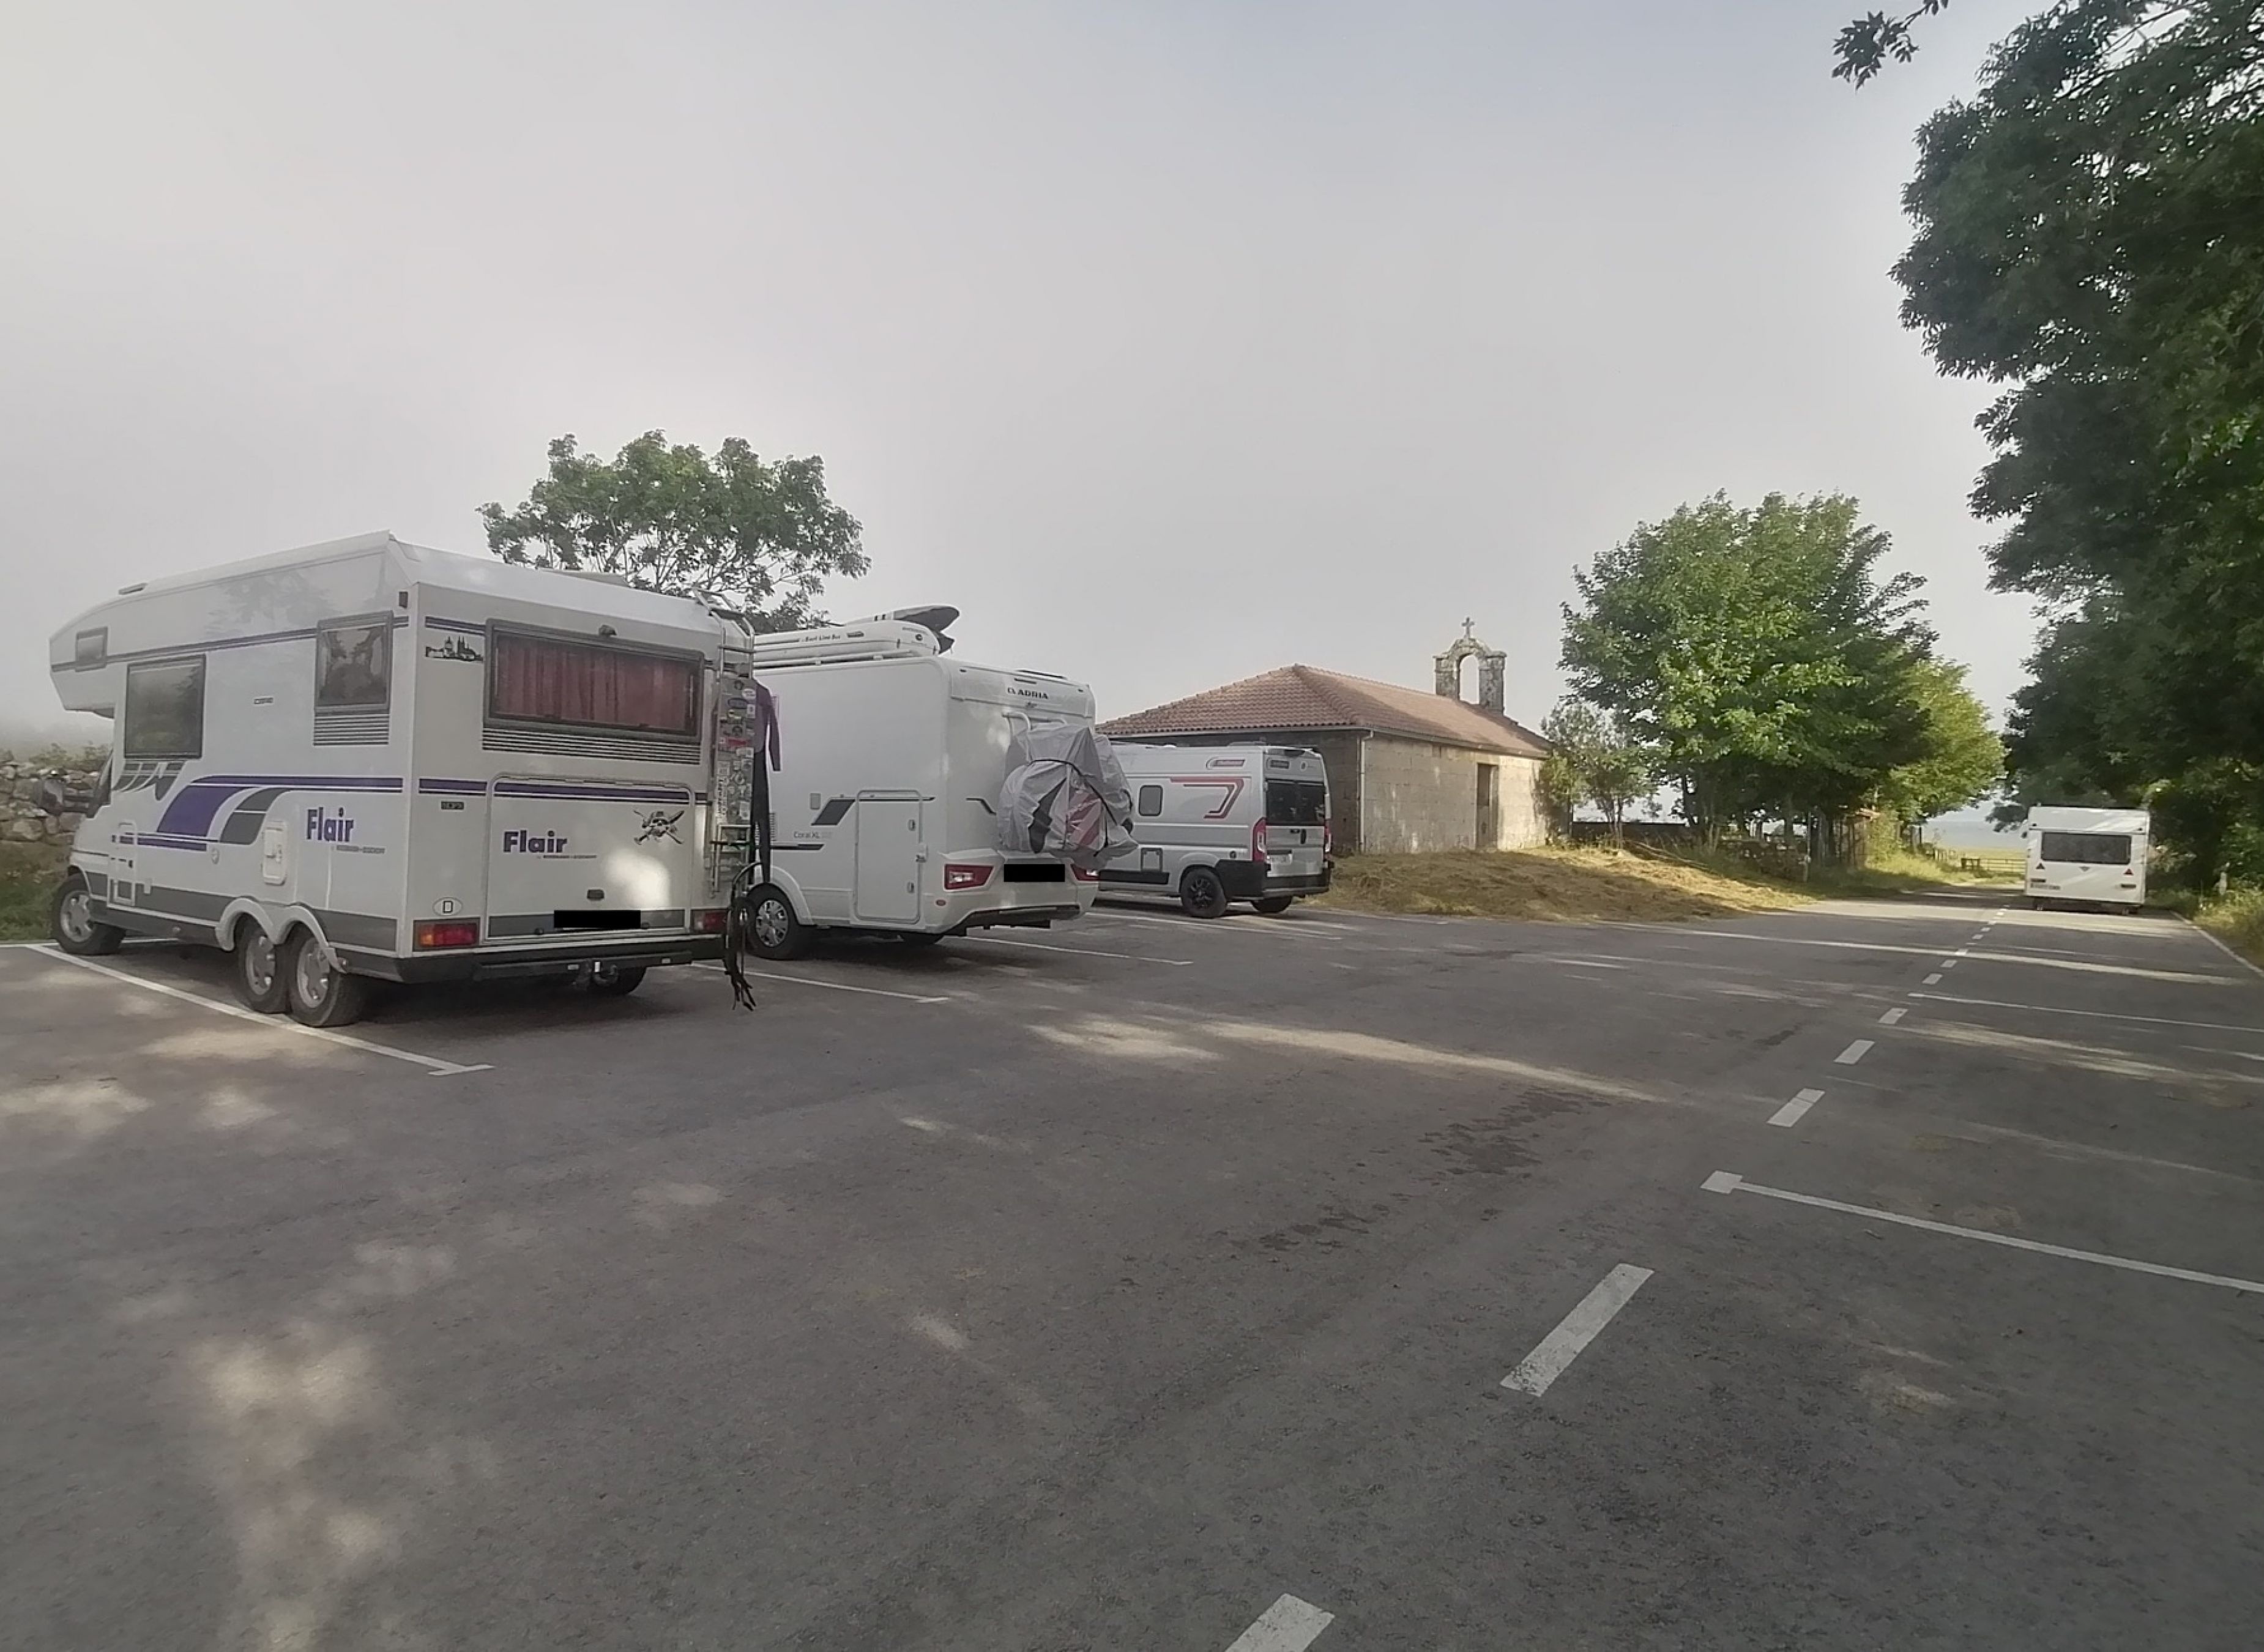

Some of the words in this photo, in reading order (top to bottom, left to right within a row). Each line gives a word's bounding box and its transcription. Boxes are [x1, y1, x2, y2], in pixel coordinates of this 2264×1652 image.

[1018, 689, 1049, 699] ADRIA
[307, 806, 354, 843] Flair
[504, 829, 568, 853] Flair
[443, 901, 453, 913] D
